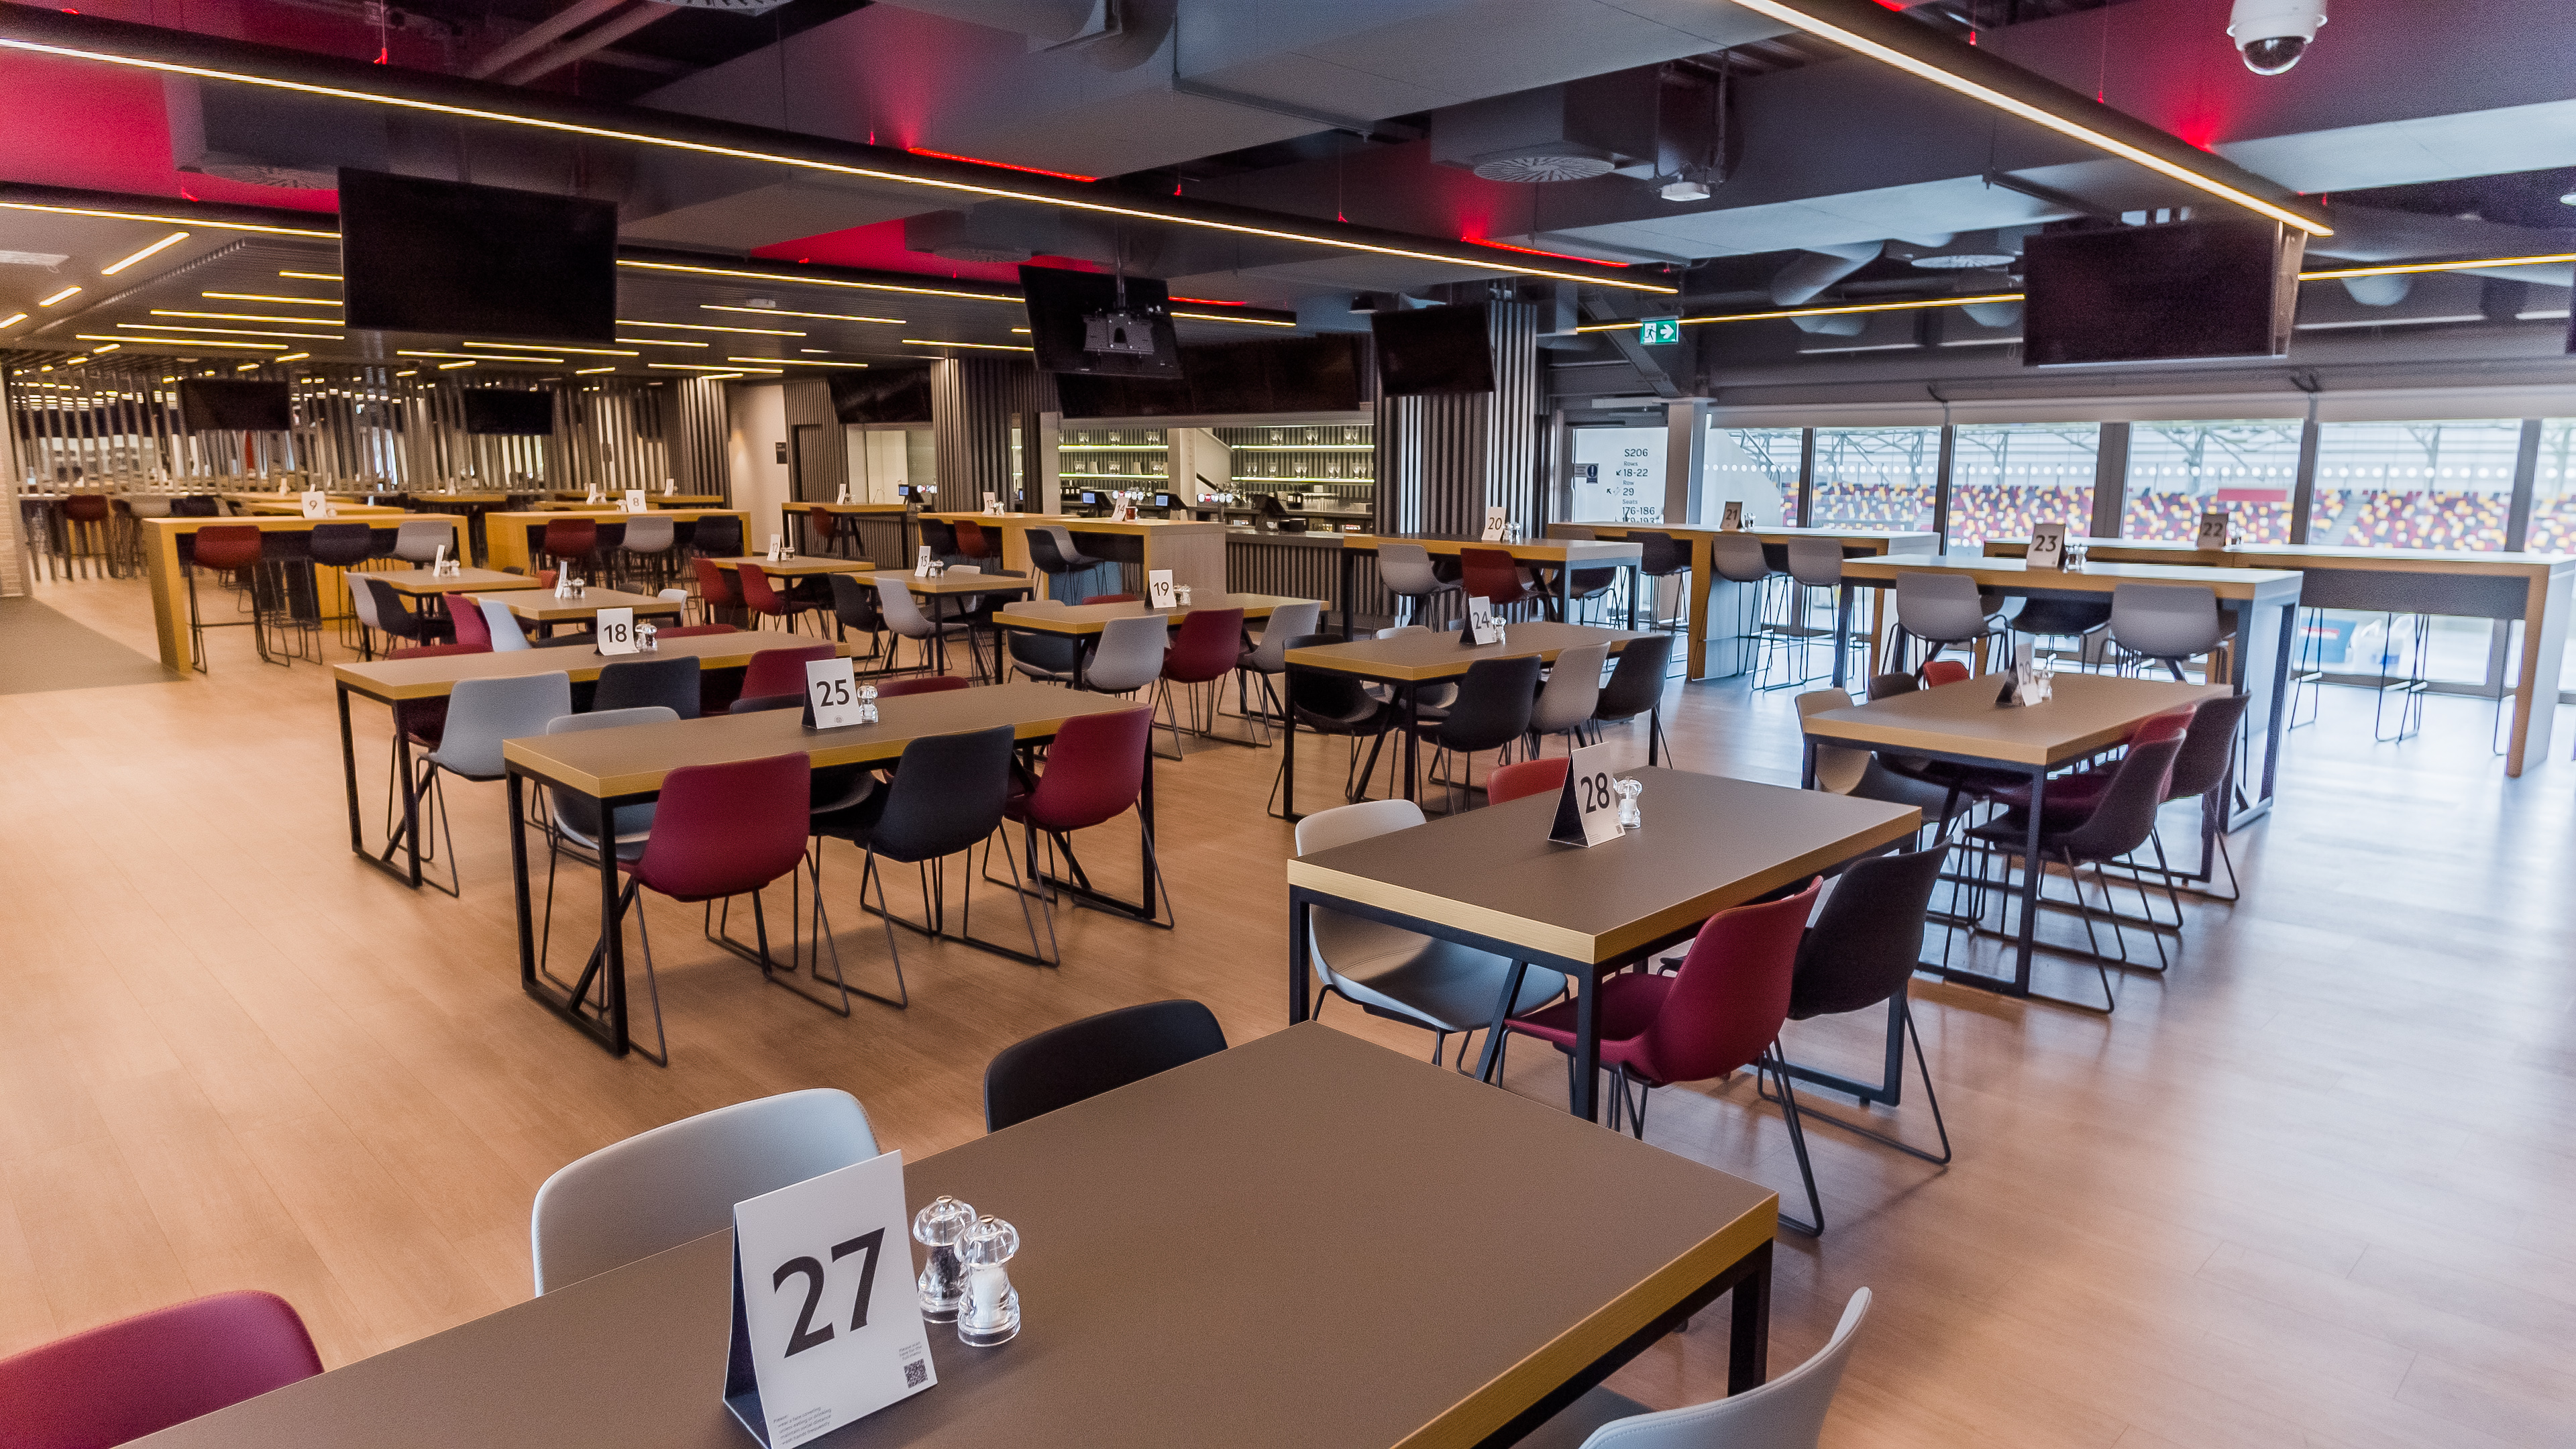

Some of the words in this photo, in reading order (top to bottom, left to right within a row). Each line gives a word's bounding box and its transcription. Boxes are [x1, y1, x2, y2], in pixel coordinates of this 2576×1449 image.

[1624, 449, 1648, 457] S206
[1623, 468, 1648, 477] 18-22
[1623, 488, 1634, 496] 29
[309, 500, 317, 510] 9
[633, 497, 639, 506] 8
[1117, 504, 1126, 514] 14
[1622, 506, 1655, 515] 176-186
[1726, 508, 1737, 521] 21
[1488, 517, 1502, 530] 20
[2203, 522, 2223, 537] 22
[772, 542, 778, 553] 12
[2034, 535, 2058, 551] 23
[920, 555, 928, 567] 15
[1154, 582, 1169, 596] 19
[1473, 610, 1490, 629] 24
[604, 623, 627, 643] 18
[2019, 661, 2031, 685] 29
[816, 678, 850, 707] 25
[1580, 771, 1610, 814] 28
[772, 1226, 886, 1359] 27
